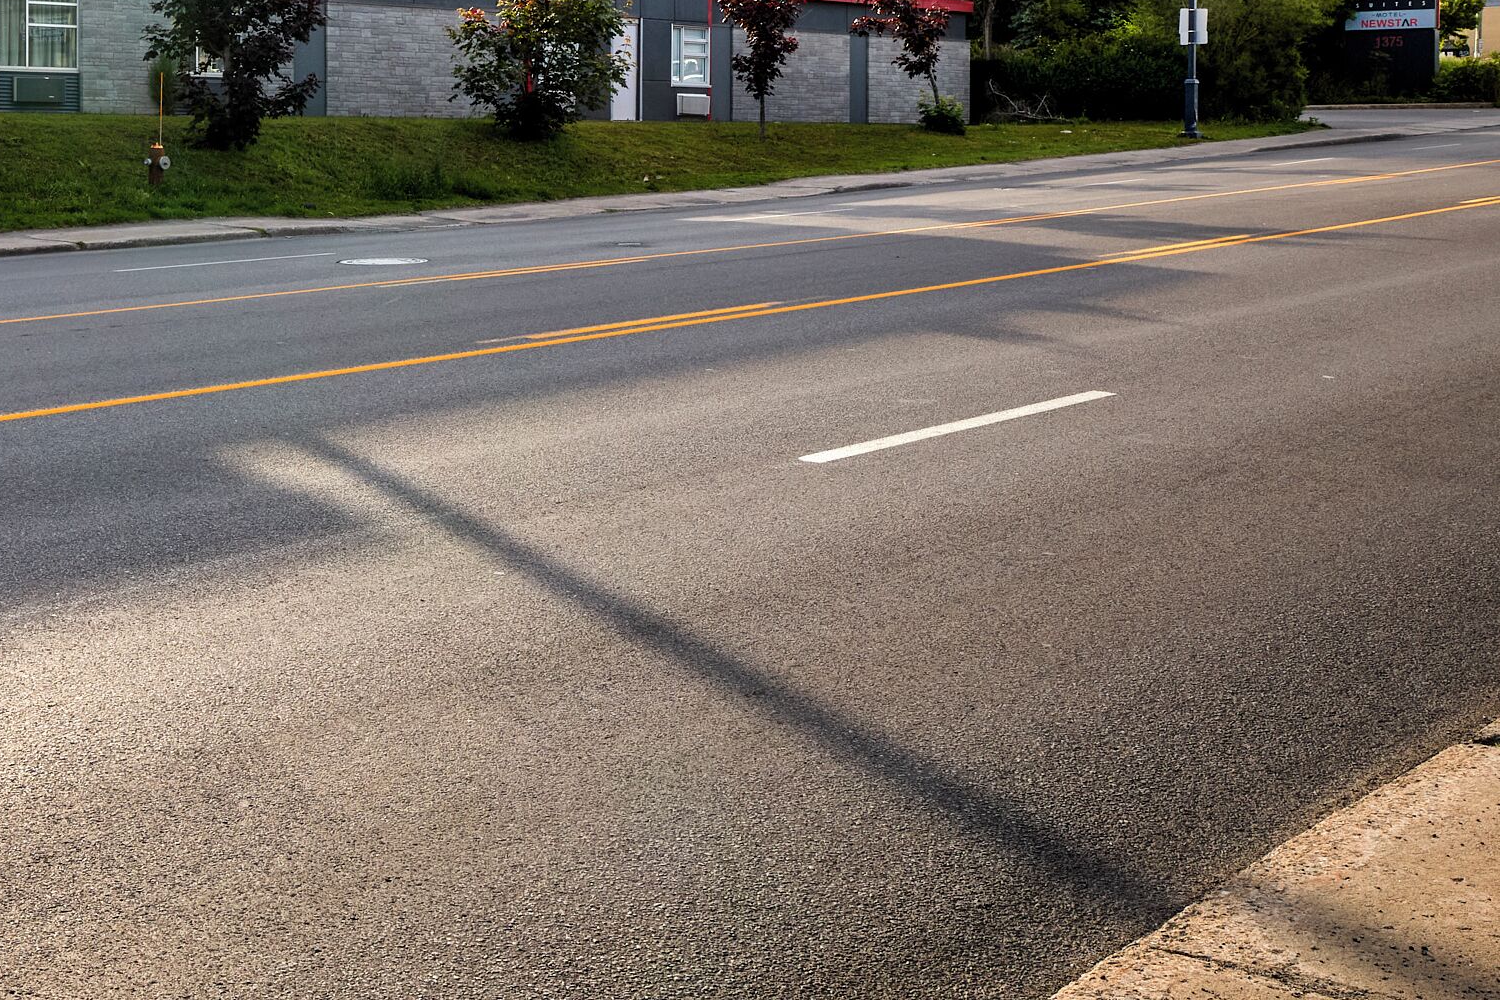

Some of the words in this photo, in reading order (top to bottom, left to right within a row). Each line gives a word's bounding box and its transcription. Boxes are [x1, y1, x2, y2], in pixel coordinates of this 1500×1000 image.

[1355, 0, 1426, 9] SUITES
[1361, 18, 1418, 28] NEWSTAR
[1375, 35, 1404, 49] 1375
